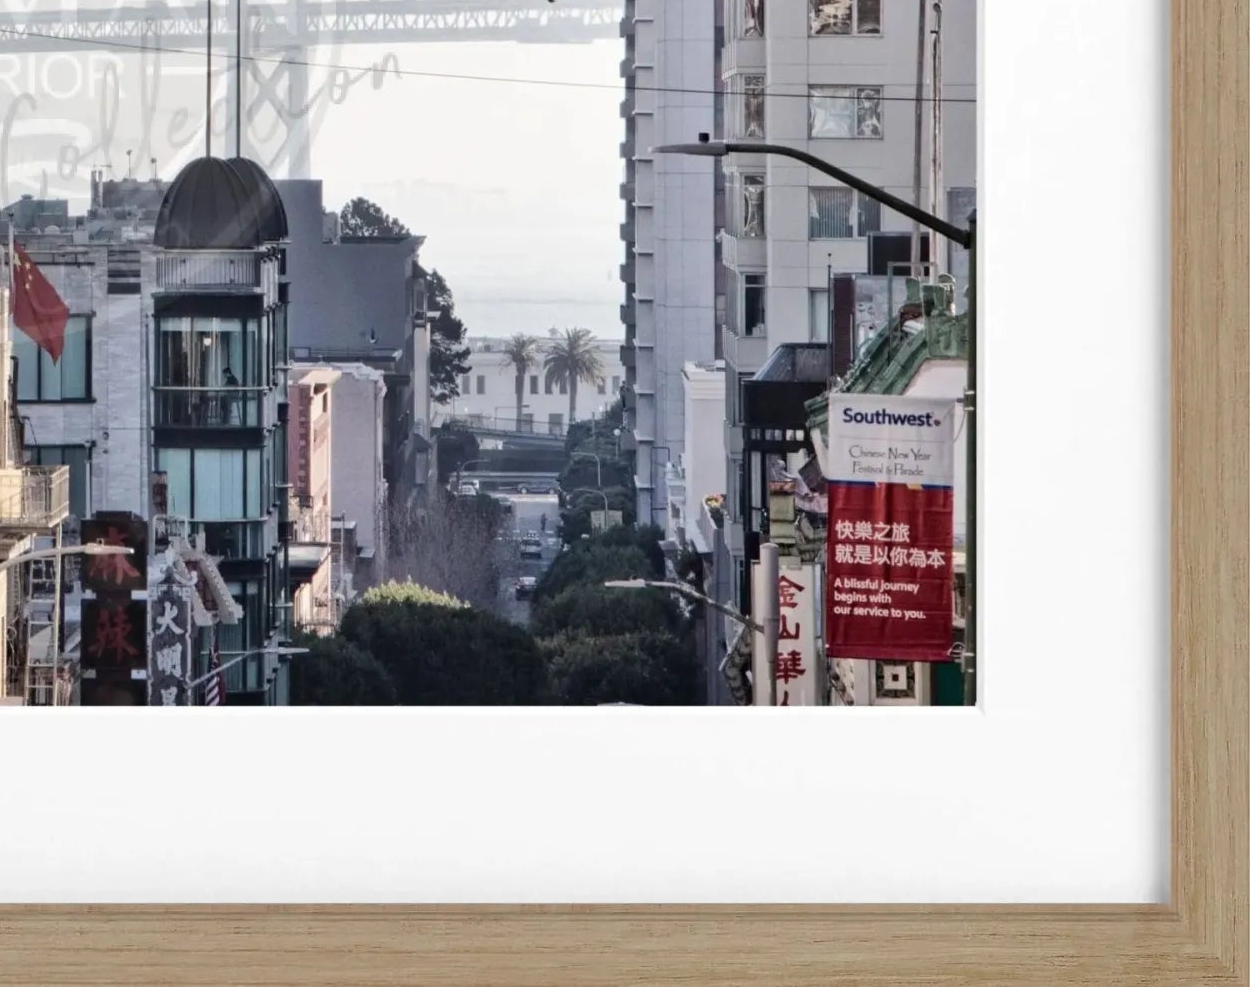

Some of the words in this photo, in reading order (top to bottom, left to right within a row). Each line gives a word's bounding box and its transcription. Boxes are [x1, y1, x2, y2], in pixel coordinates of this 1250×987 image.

[843, 408, 933, 427] Southwest
[849, 444, 886, 459] Chinese
[888, 447, 910, 460] New
[910, 448, 932, 461] Year
[894, 462, 925, 476] Parade
[834, 519, 910, 543] 快樂之旅
[834, 544, 946, 569] 就是以你為本
[834, 578, 843, 588] A
[844, 577, 879, 589] blissful
[879, 580, 920, 595] journey
[834, 591, 867, 604] begins
[869, 593, 892, 604] with
[834, 606, 851, 615] our
[853, 606, 889, 617] service
[890, 608, 903, 618] to
[903, 609, 927, 621] you.
